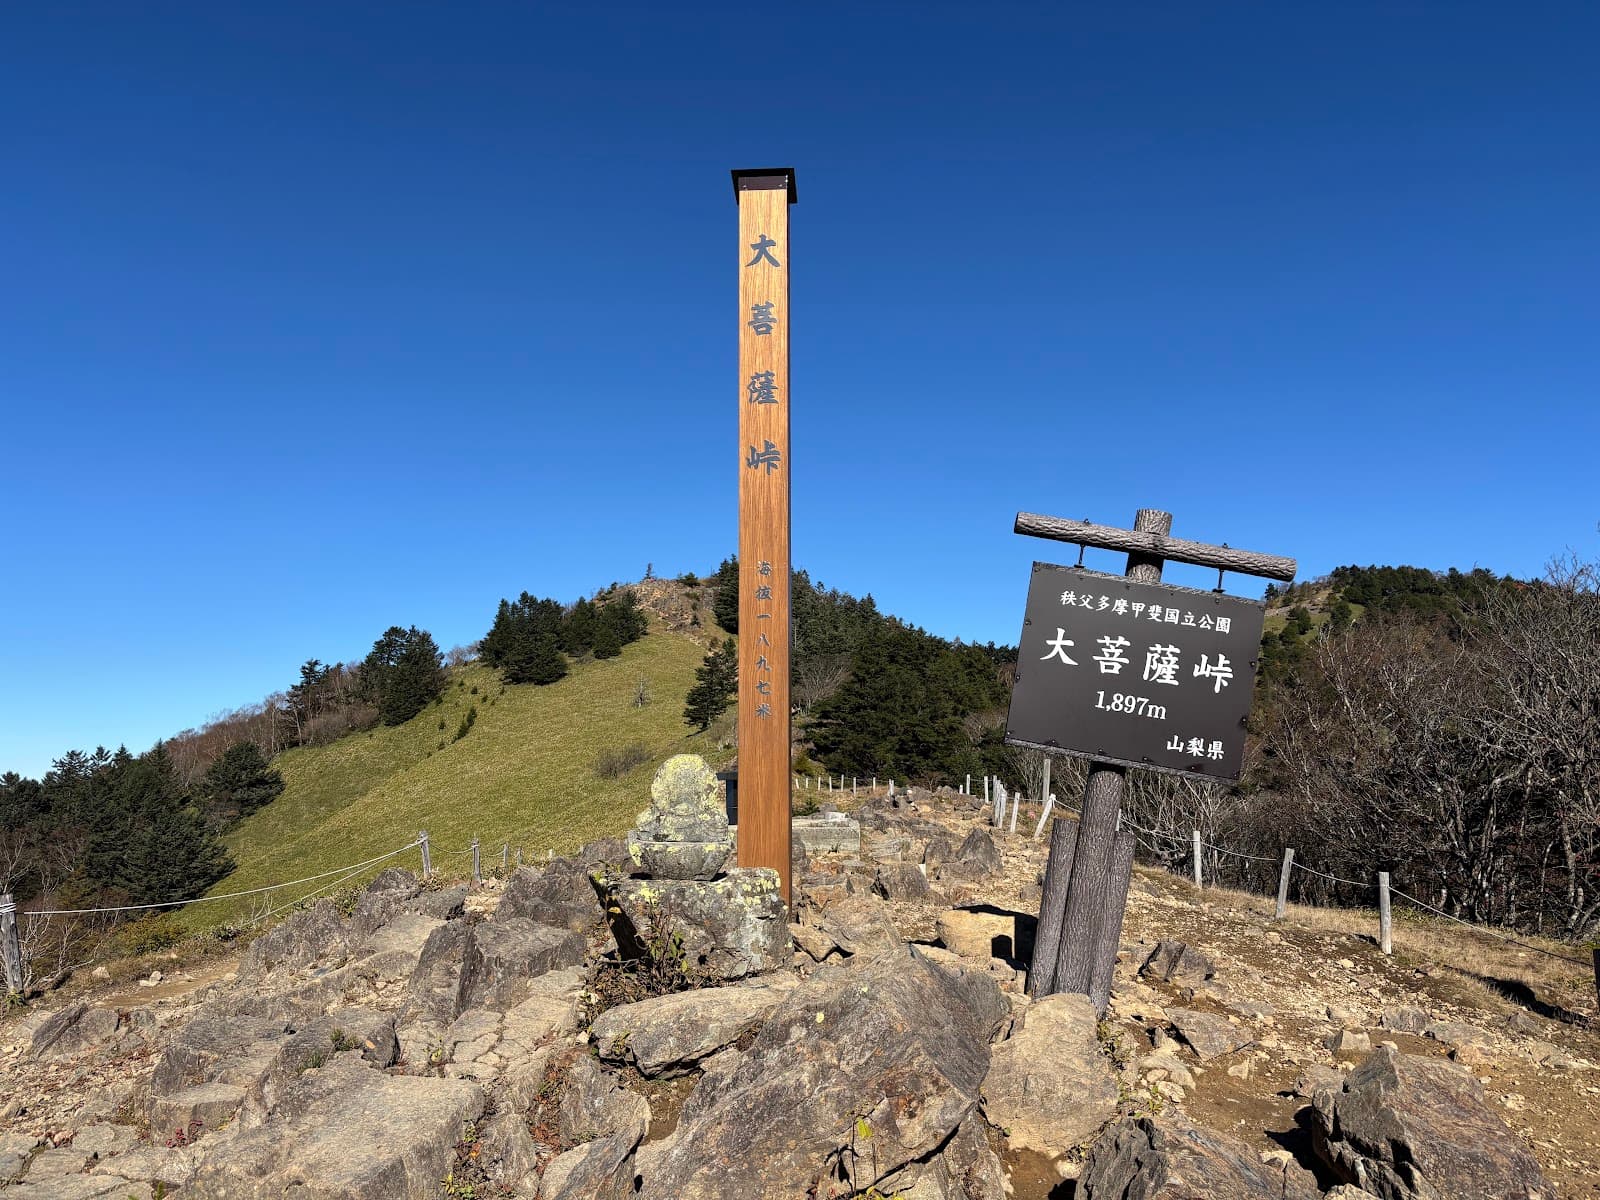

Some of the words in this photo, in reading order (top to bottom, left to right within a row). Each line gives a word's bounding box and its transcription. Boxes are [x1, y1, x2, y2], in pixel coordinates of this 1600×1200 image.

[745, 234, 781, 476] 大菩薩峠
[1060, 590, 1231, 634] 秩父多摩甲斐国立公園
[1040, 627, 1234, 694] 大菩薩峠
[1094, 690, 1167, 720] 1,897m
[1166, 734, 1225, 760] 山梨県
